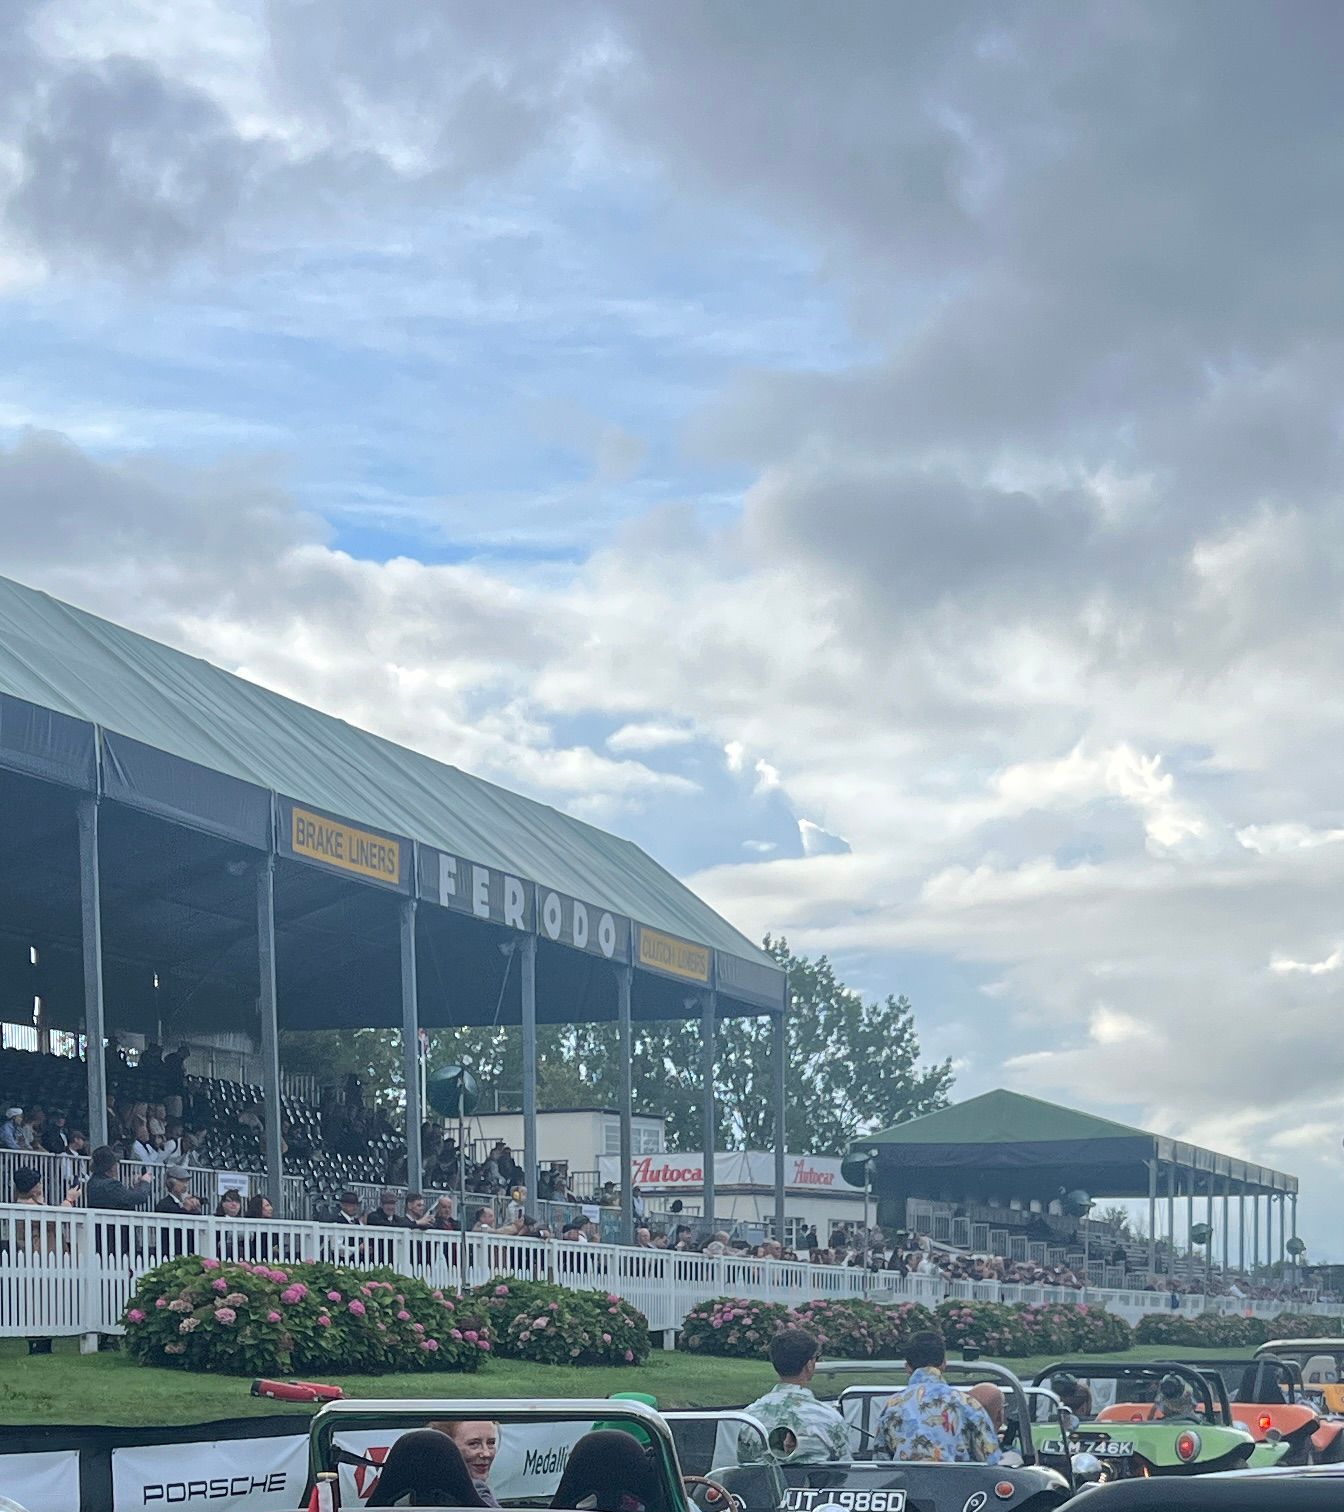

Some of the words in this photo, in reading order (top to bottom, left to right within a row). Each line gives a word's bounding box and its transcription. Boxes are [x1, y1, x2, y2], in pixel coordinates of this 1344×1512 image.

[296, 817, 343, 860] BRAKE
[349, 834, 395, 875] LINERS
[439, 853, 616, 958] FERODO
[632, 1157, 704, 1185] Autoca
[523, 1445, 570, 1476] Medalli
[1084, 1441, 1131, 1455] 746K
[143, 1473, 287, 1505] PORSCHE
